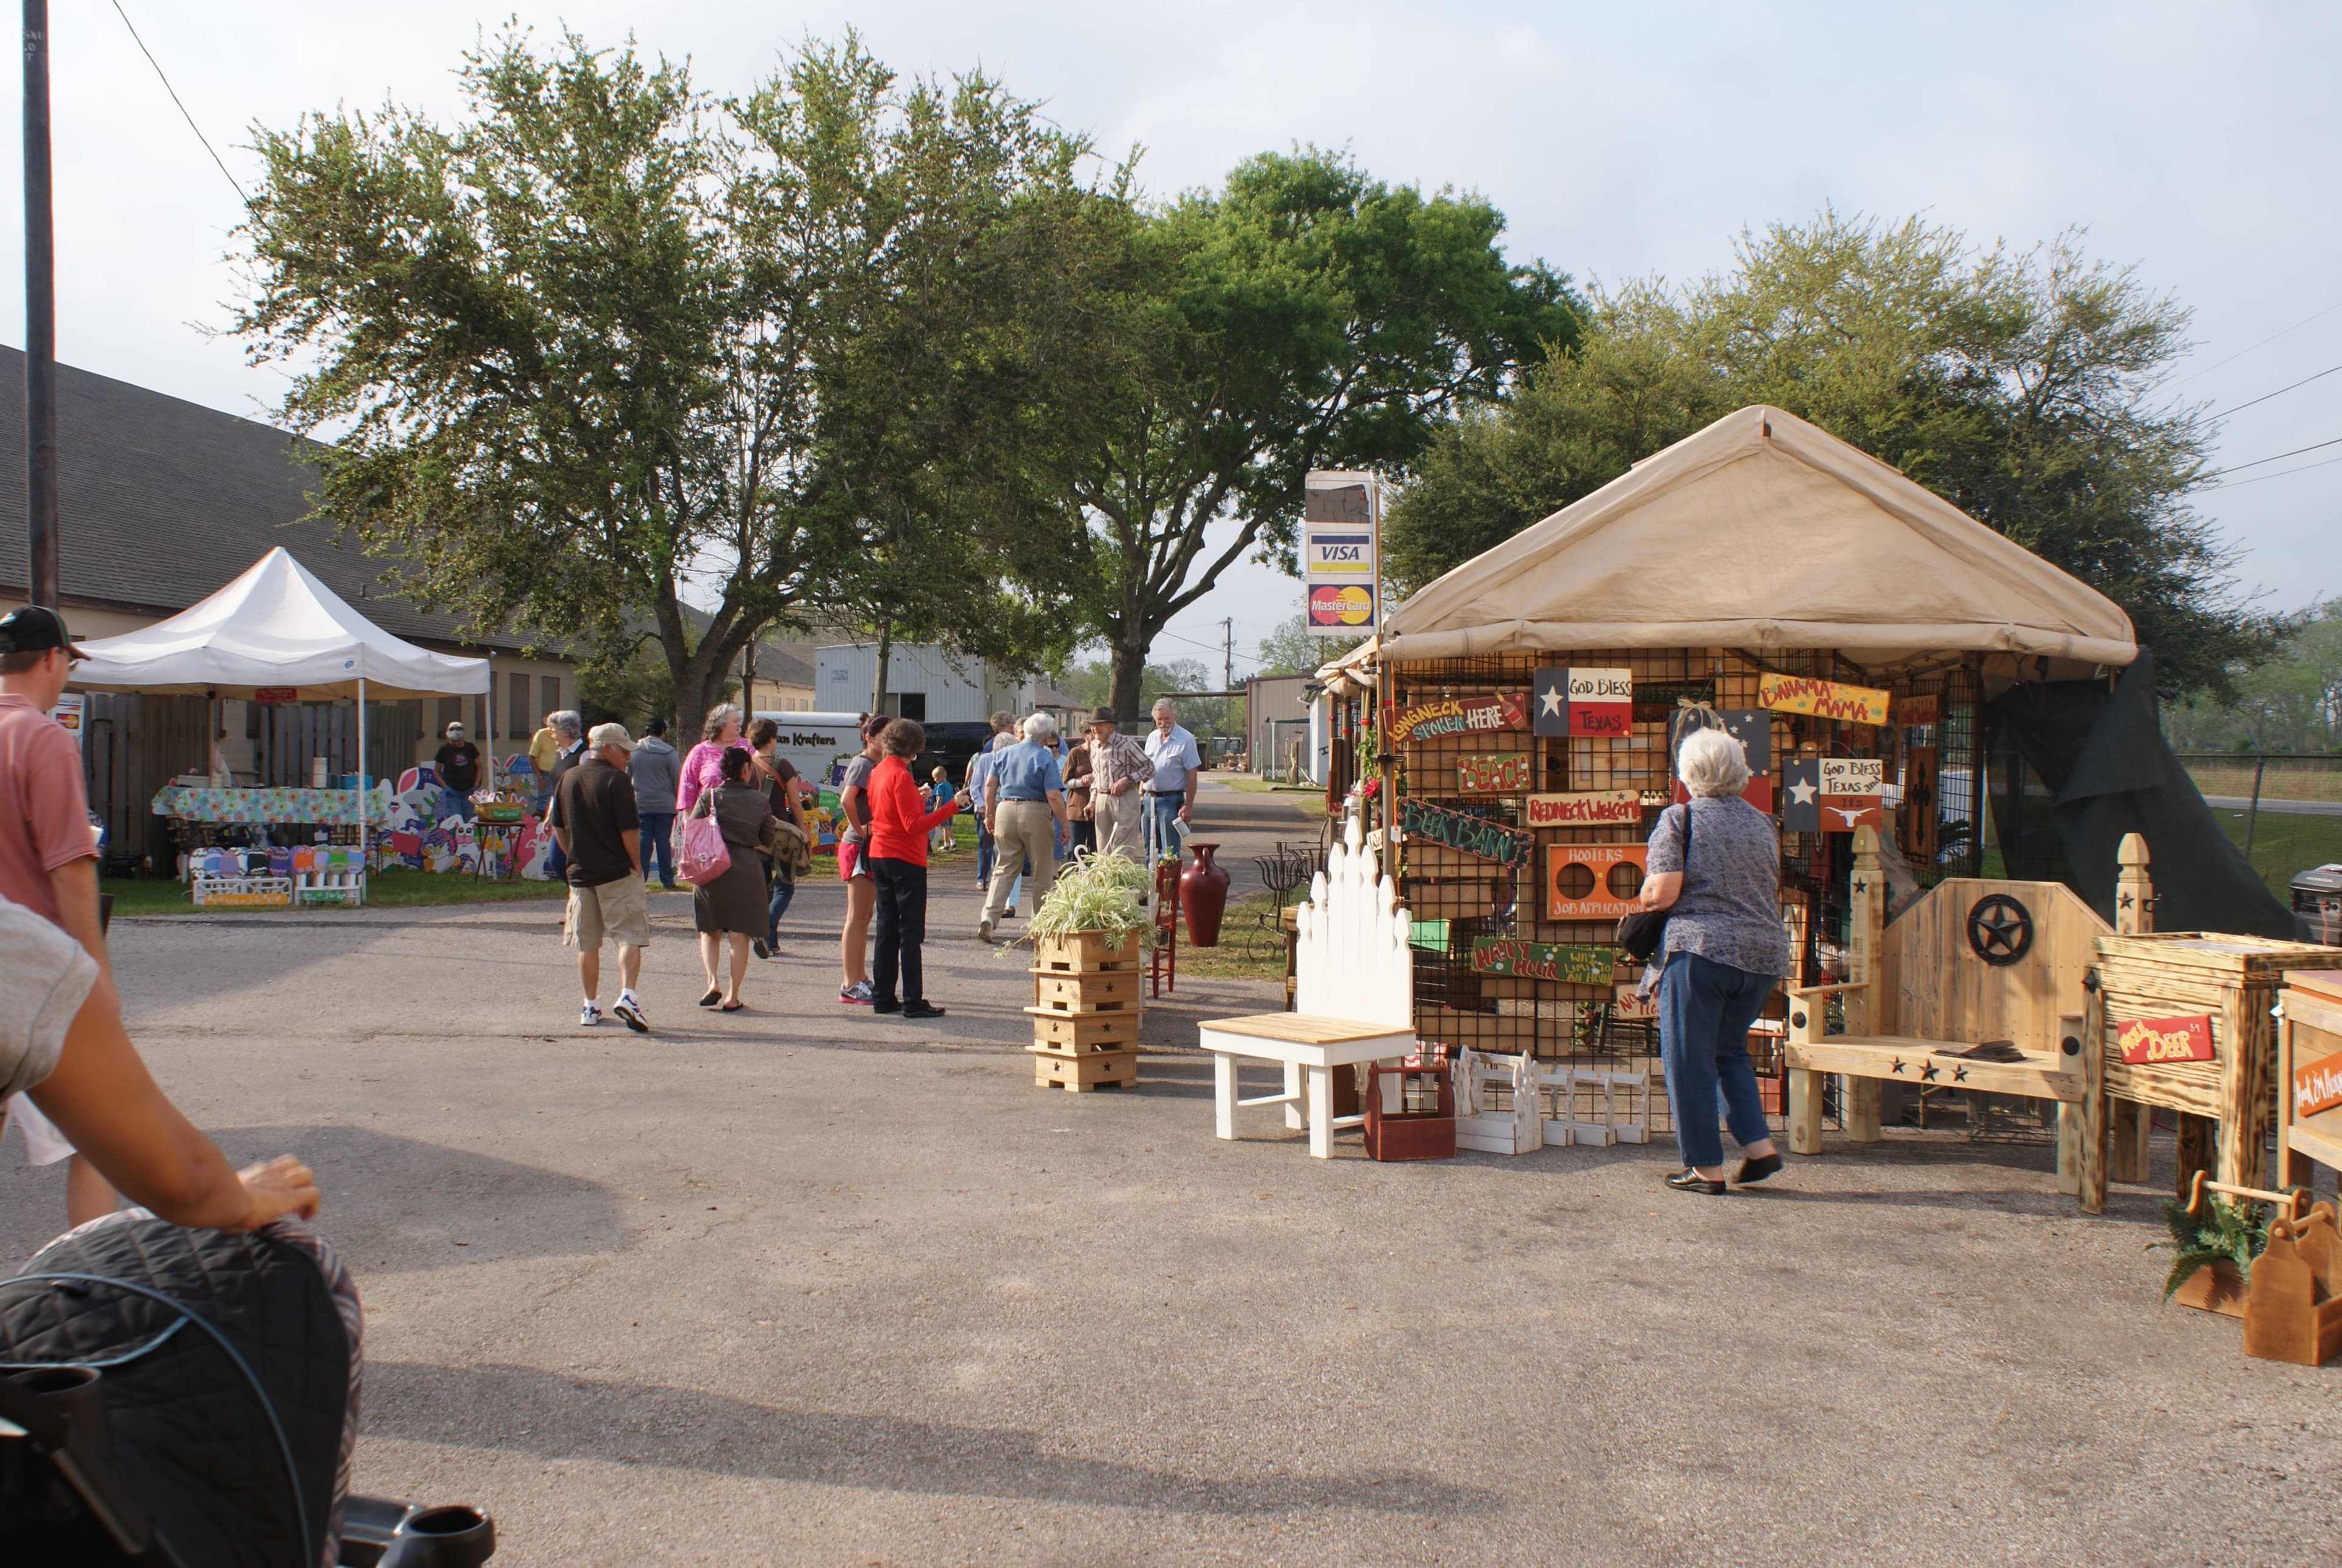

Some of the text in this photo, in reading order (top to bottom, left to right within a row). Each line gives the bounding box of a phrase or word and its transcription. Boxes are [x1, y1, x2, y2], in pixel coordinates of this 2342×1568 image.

[1322, 546, 1359, 560] VISA
[1311, 600, 1369, 611] MasterCard
[1761, 679, 1832, 707] BAHAMA
[1813, 698, 1868, 720] MAMA
[1388, 701, 1463, 742] LONGNECK
[1413, 705, 1505, 741] SPOKEN HERE
[1578, 711, 1621, 732] TEXAS
[793, 732, 836, 747] Krafters
[1458, 756, 1530, 792] BEACH
[1825, 777, 1861, 793] TEXAS
[1529, 799, 1588, 822] REDNECK
[1402, 803, 1451, 846] BEER
[1453, 818, 1512, 862] BARN
[1569, 848, 1623, 862] HOOTERS
[1554, 901, 1577, 915] JOB
[1475, 942, 1529, 970] HAPPY
[1513, 958, 1559, 979] HOUR
